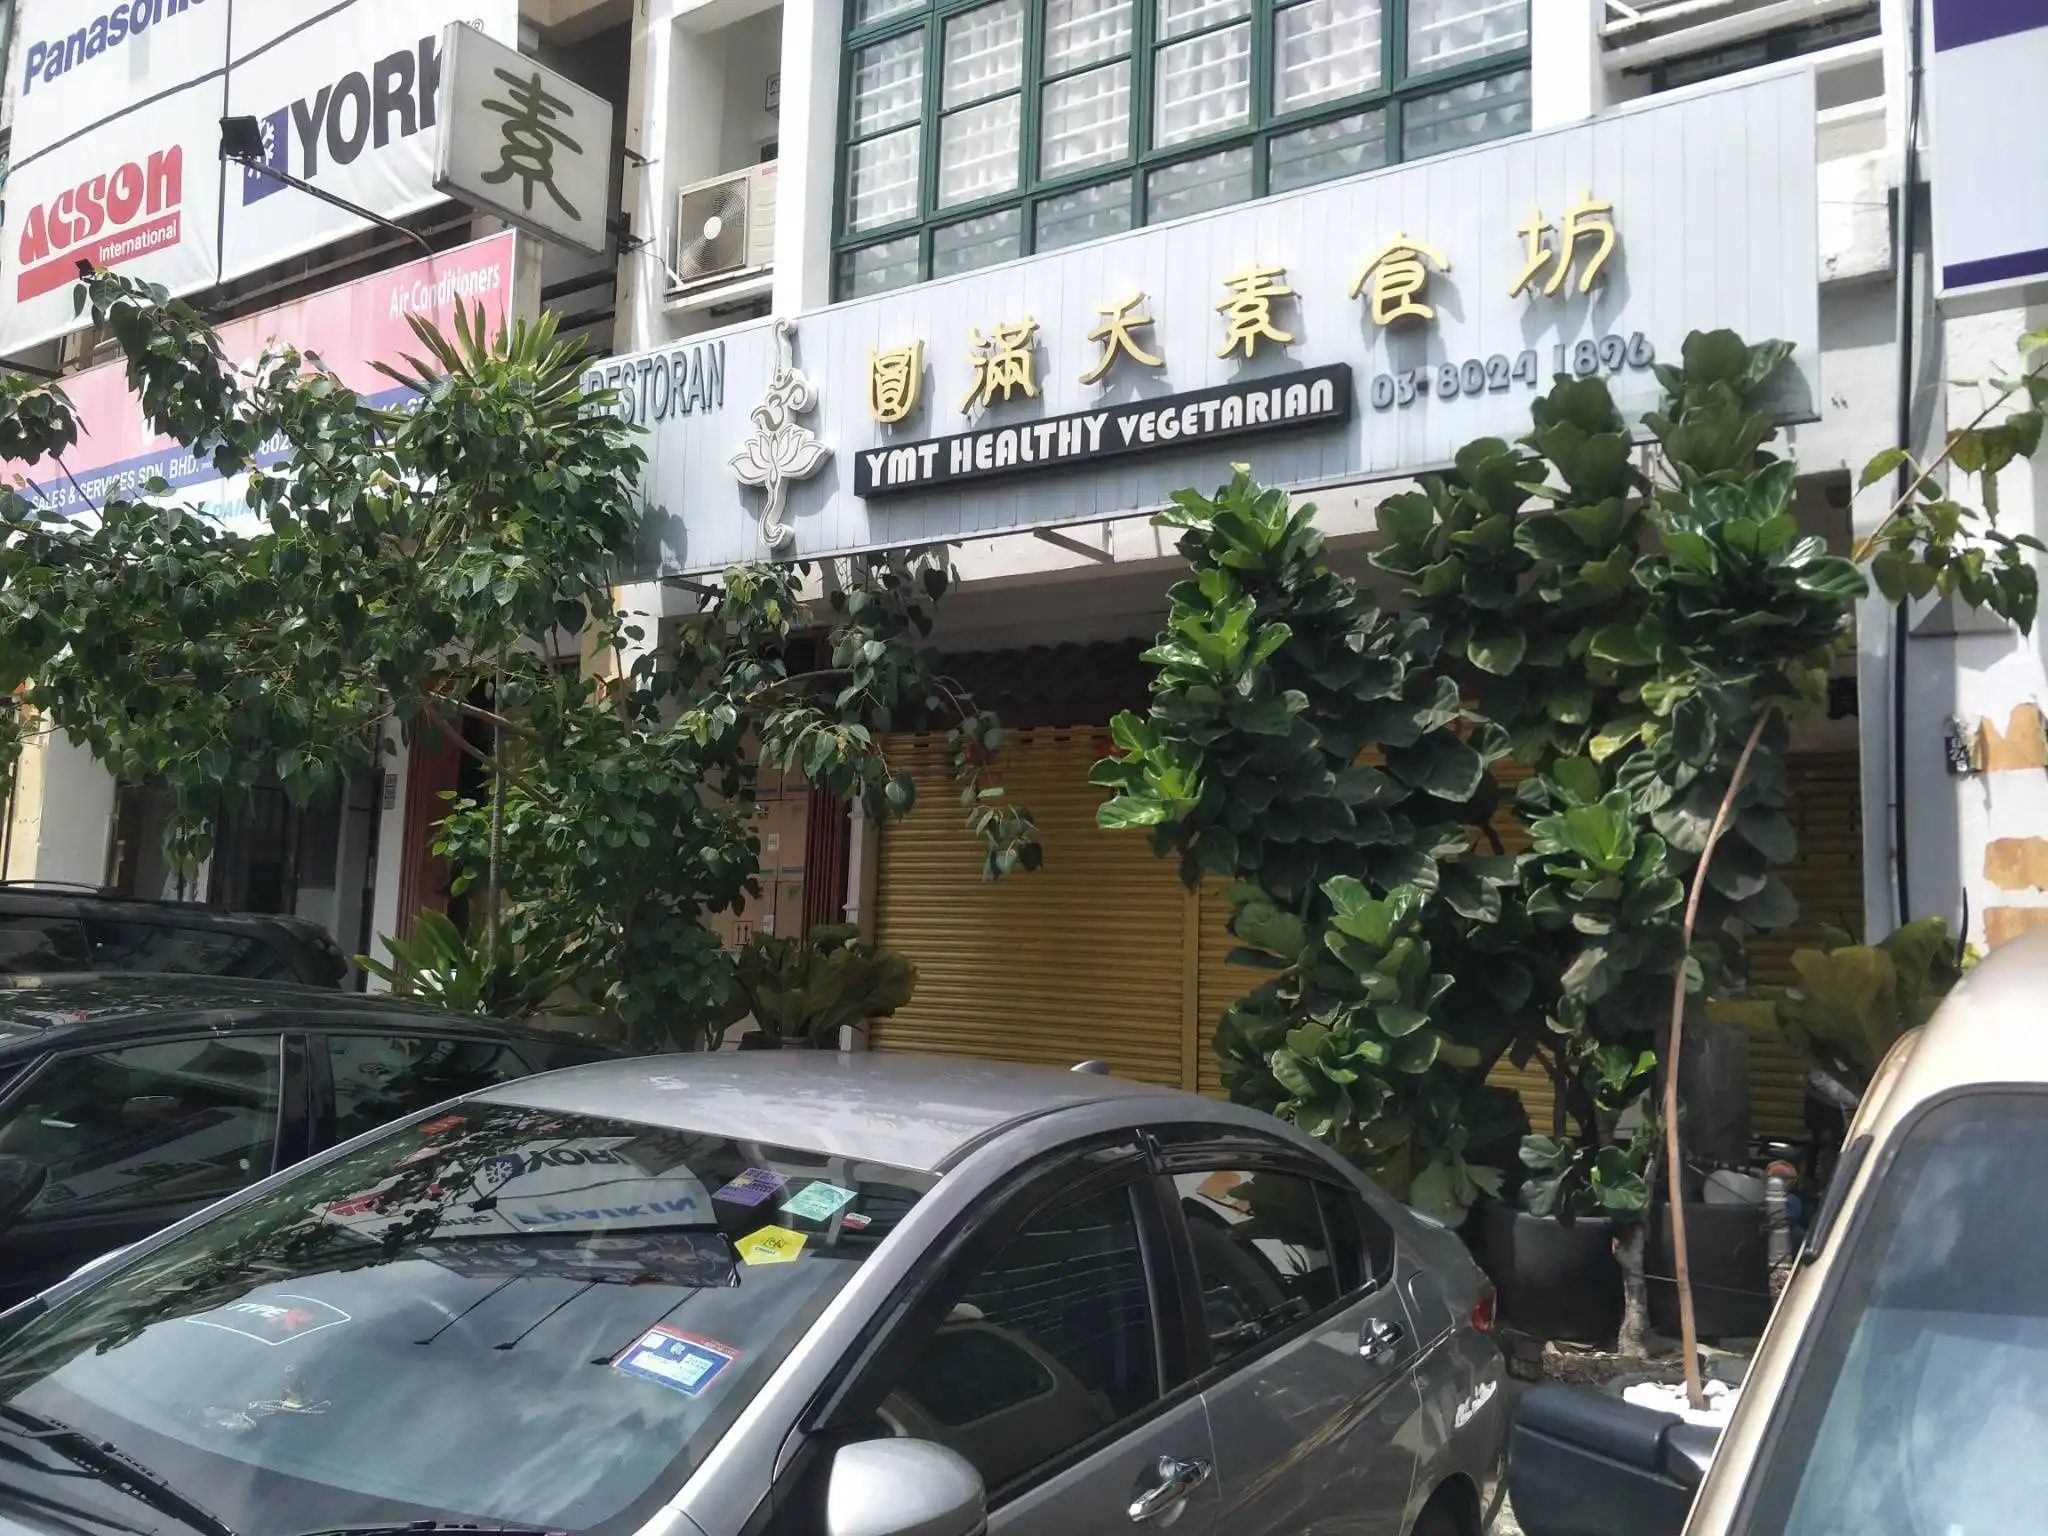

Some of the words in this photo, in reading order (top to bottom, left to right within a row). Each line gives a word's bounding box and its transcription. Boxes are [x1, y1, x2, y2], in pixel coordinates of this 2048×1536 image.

[23, 0, 206, 96] Panason
[481, 72, 583, 222] 素
[99, 219, 178, 263] International
[389, 284, 409, 321] Air
[412, 263, 500, 312] Conditioners
[1371, 350, 1539, 409] 03-8024
[1551, 331, 1656, 377] 1896
[866, 443, 939, 487] YMT
[950, 412, 1111, 474] HEALTHY
[1117, 378, 1335, 446] VEGETARIAN
[69, 486, 78, 504] &
[169, 455, 199, 479] BHD.
